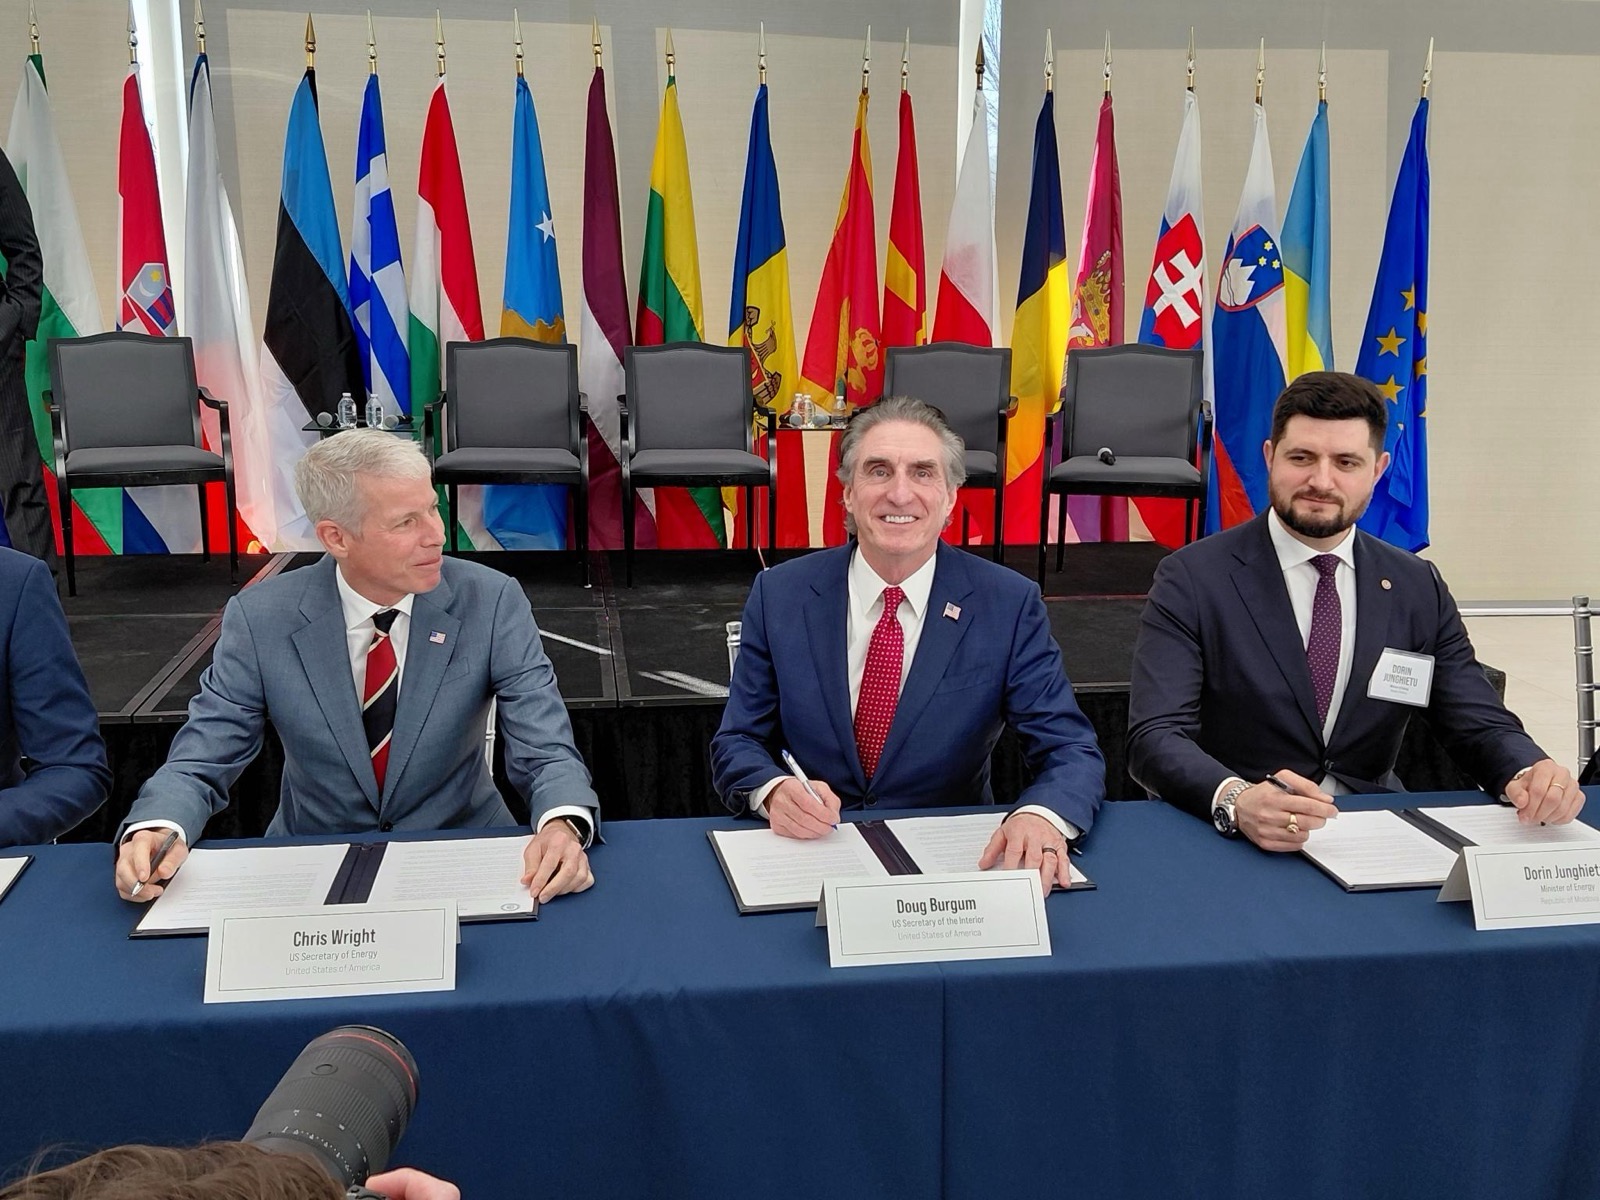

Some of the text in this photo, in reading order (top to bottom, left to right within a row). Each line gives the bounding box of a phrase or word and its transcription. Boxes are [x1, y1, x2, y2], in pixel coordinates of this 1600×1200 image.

[1392, 664, 1412, 676] DORIN
[1383, 673, 1418, 687] JUNGHIETU
[1524, 864, 1600, 881] Dorin Junghiet
[1540, 883, 1596, 893] Minister of Energy
[896, 897, 977, 916] Doug Burgum
[892, 916, 985, 928] US Secretary of the Interior
[293, 928, 376, 947] Chris Wright
[898, 932, 920, 941] United
[922, 931, 944, 940] States
[954, 929, 982, 938] America
[289, 949, 378, 962] US Secretary of Energy
[285, 963, 381, 976] United States of America
